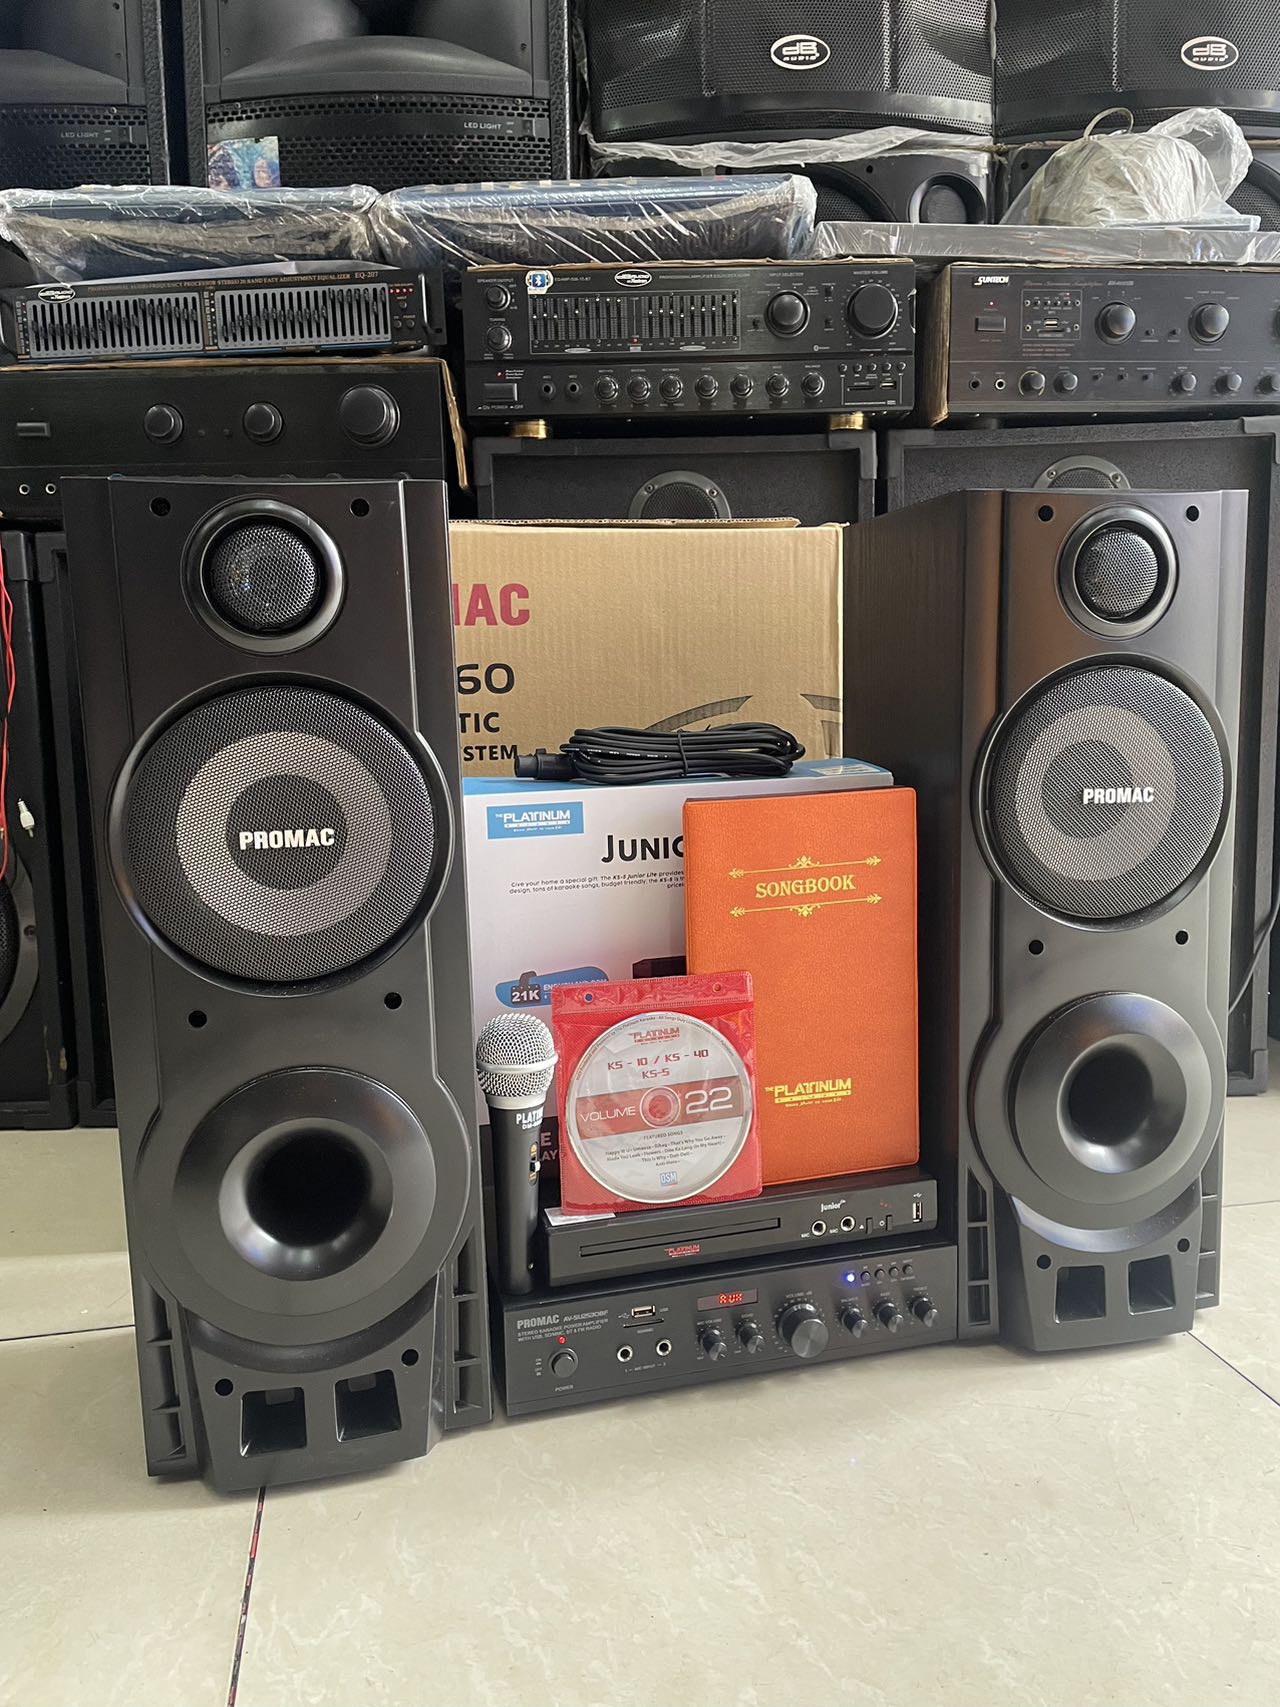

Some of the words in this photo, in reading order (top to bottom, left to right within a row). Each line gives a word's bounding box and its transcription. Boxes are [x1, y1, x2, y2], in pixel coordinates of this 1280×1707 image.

[782, 42, 817, 56] dB
[1192, 43, 1227, 56] dB
[463, 121, 479, 129] LED
[479, 122, 502, 131] LIGHT
[354, 270, 379, 279] EQ-207
[1083, 787, 1155, 804] PROMAC
[503, 810, 571, 823] PLATINUM
[239, 828, 335, 850] PROMAC
[755, 874, 857, 899] SONGBOOK
[511, 989, 541, 1002] 21K
[634, 1027, 680, 1039] PLATINUM
[607, 1060, 623, 1071] KS
[637, 1057, 648, 1066] 10
[664, 1052, 680, 1063] KS
[693, 1049, 709, 1058] 40
[642, 1067, 670, 1079] KS-5
[774, 1077, 852, 1098] PLATINUM
[685, 1086, 733, 1115] 22
[580, 1106, 636, 1122] VOLUME
[719, 1293, 743, 1304] AUX
[516, 1314, 560, 1330] PROMAC
